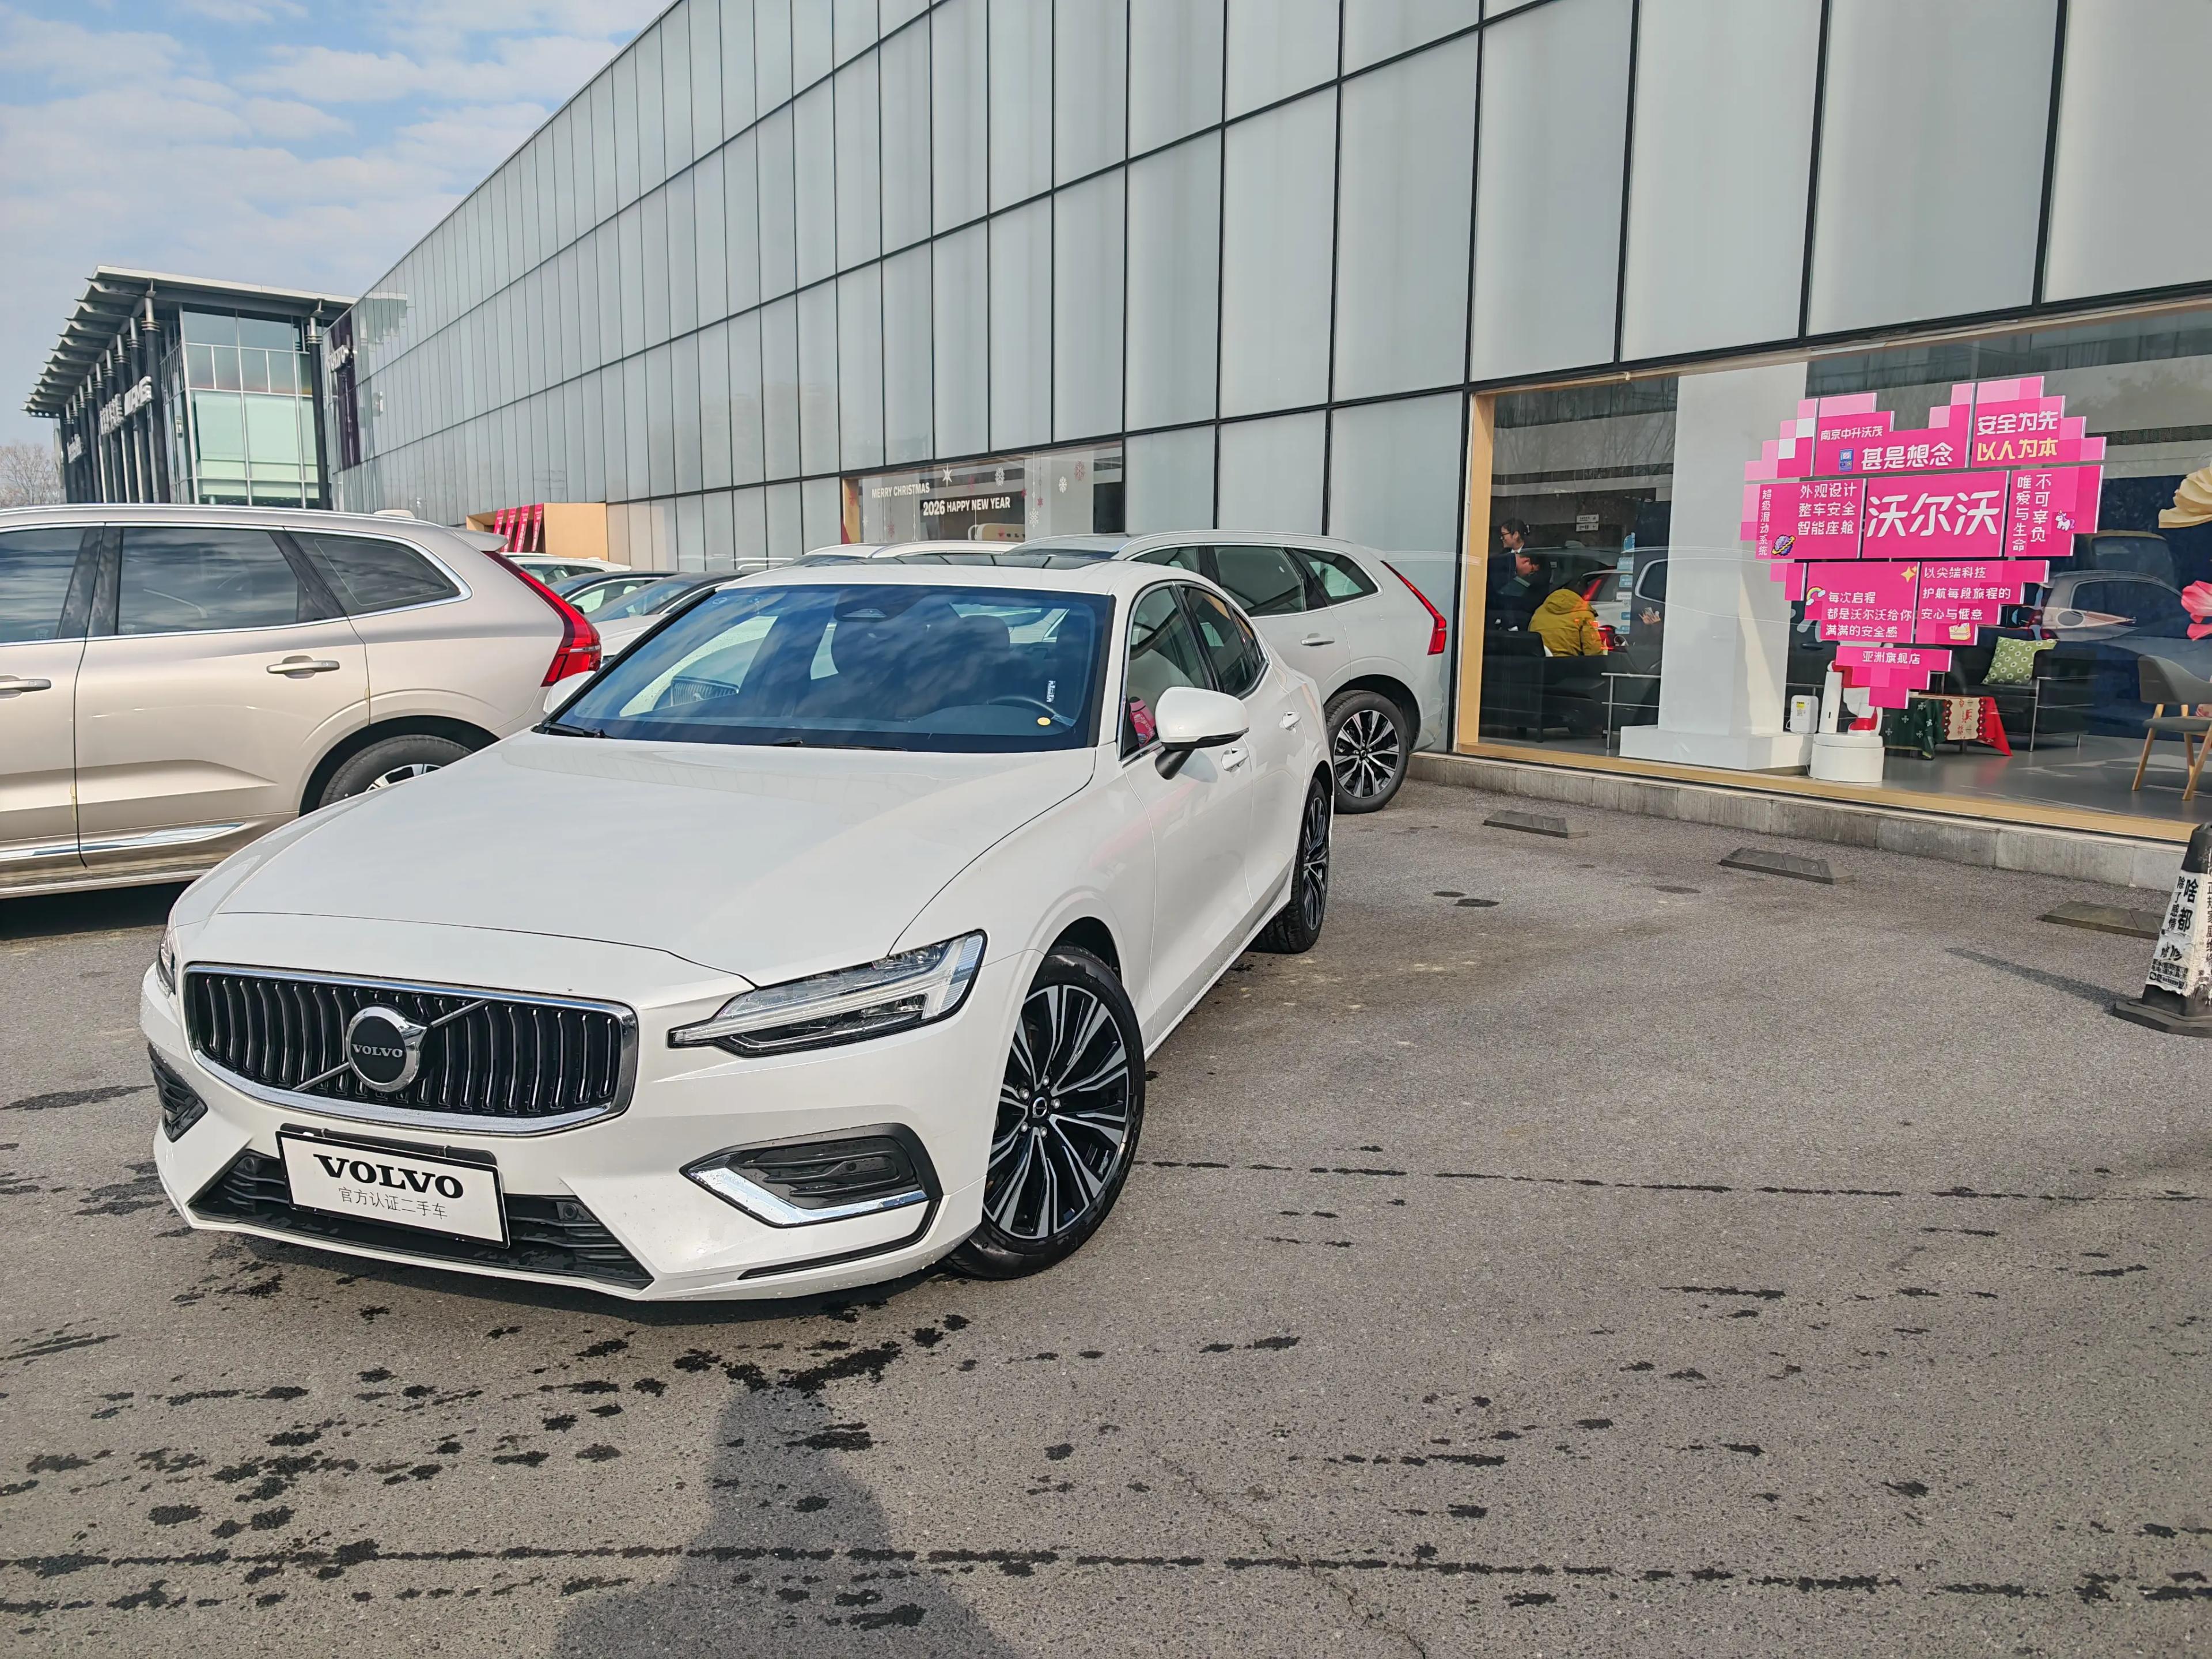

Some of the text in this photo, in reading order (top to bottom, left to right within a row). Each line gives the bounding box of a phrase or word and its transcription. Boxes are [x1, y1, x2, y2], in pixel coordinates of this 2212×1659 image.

[1977, 411, 2059, 435] 安全为先
[1820, 426, 1883, 441] 南京中升沃茂
[1861, 442, 1954, 471] 甚是想念
[1977, 437, 2059, 461] 以人为本
[872, 482, 930, 498] MERRY CHRISTMAS
[1800, 482, 1857, 499] 外观设计
[923, 497, 1010, 516] 2026 HAPPY NEW YEAR
[1798, 501, 1856, 517] 整车安全
[1866, 490, 2000, 537] 沃尔沃
[2012, 475, 2032, 551] 唯爱与生命
[2031, 474, 2052, 542] 不可辜负
[1758, 489, 1772, 556] 超级混动系统
[1797, 520, 1854, 535] 智能座舱
[1924, 566, 1987, 578] 以尖端科技
[1828, 592, 1876, 604] 每次启程
[1922, 587, 2011, 599] 护航每段旅程的
[1827, 608, 1912, 621] 都是沃尔沃给你
[1921, 608, 1983, 620] 安心与惬意
[1825, 624, 1898, 638] 满满的安全感
[1862, 651, 1921, 664] 亚洲旗舰店
[351, 1044, 403, 1058] VOLVO
[313, 1153, 464, 1199] VOLVO
[338, 1186, 448, 1220] 官方认证二手车
